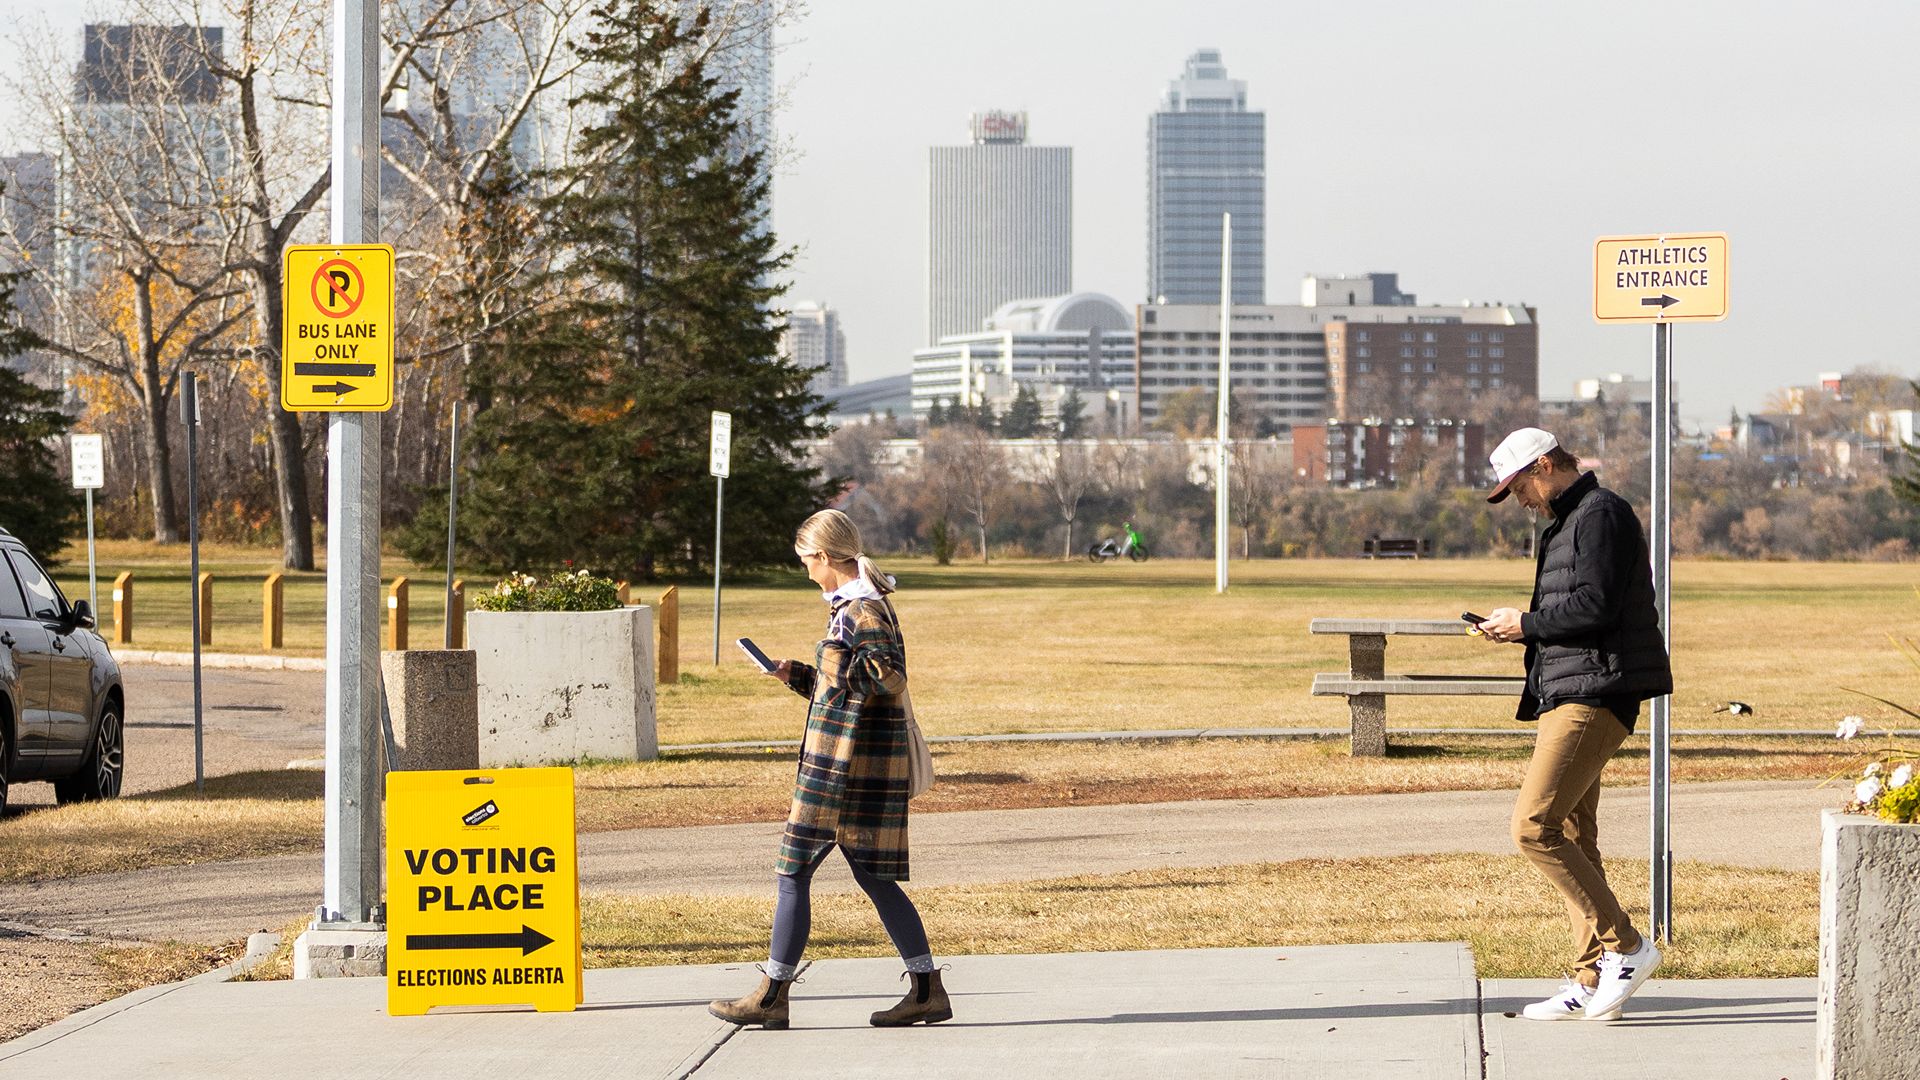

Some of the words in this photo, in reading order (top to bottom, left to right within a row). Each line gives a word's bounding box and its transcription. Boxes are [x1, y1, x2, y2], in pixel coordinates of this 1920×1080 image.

[1617, 246, 1708, 266] ATHLETICS
[1616, 269, 1708, 289] ENTRANCE
[298, 323, 330, 339] BUS
[335, 323, 377, 339] LANE
[315, 344, 359, 360] ONLY
[403, 846, 556, 876] VOTING
[418, 883, 545, 912] PLACE
[397, 968, 487, 987] ELECTIONS
[492, 967, 564, 986] ALBERTA
[1617, 966, 1636, 980] N
[1563, 997, 1583, 1012] N
